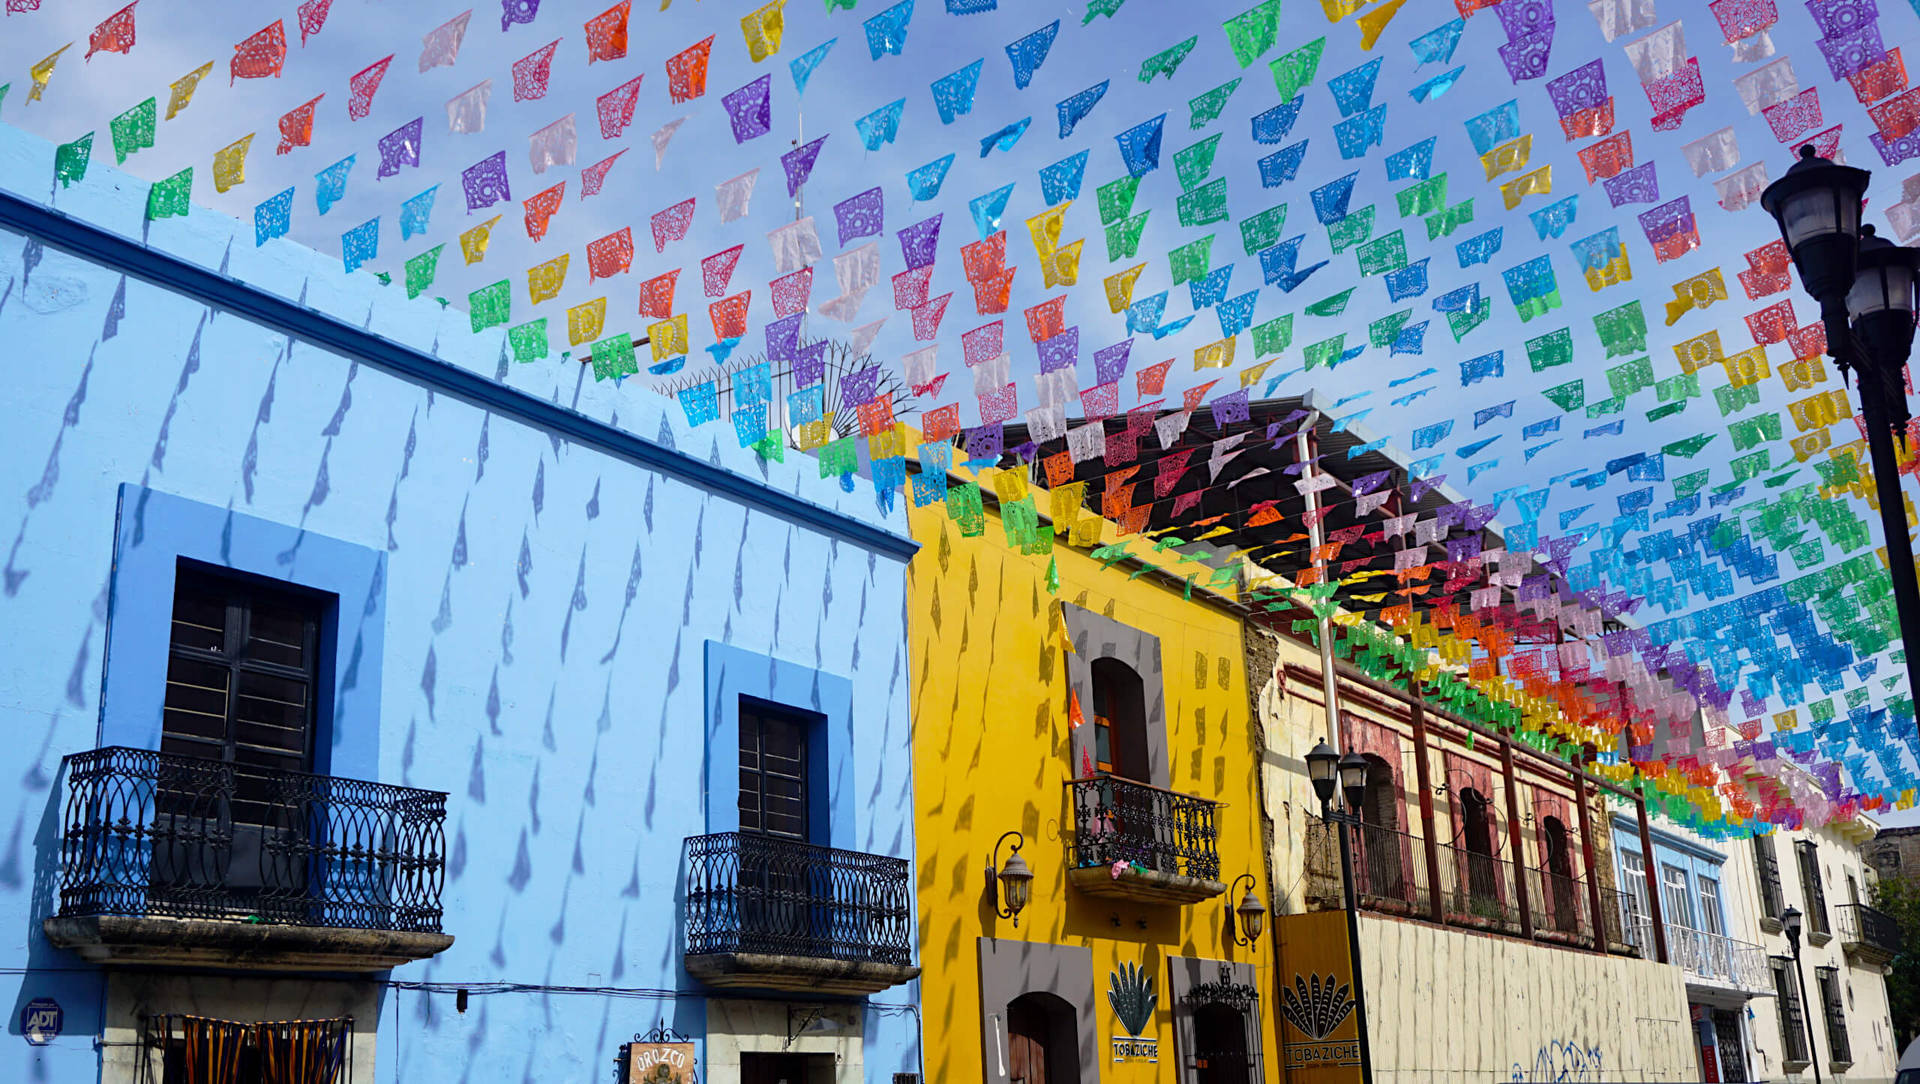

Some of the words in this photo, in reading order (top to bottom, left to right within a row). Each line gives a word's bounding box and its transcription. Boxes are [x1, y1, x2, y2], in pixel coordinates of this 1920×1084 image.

[27, 1011, 57, 1028] ADT
[1113, 1043, 1158, 1057] TOBAZICHE
[1286, 1044, 1360, 1063] TOBAZICHE
[637, 1047, 685, 1072] OROZCO
